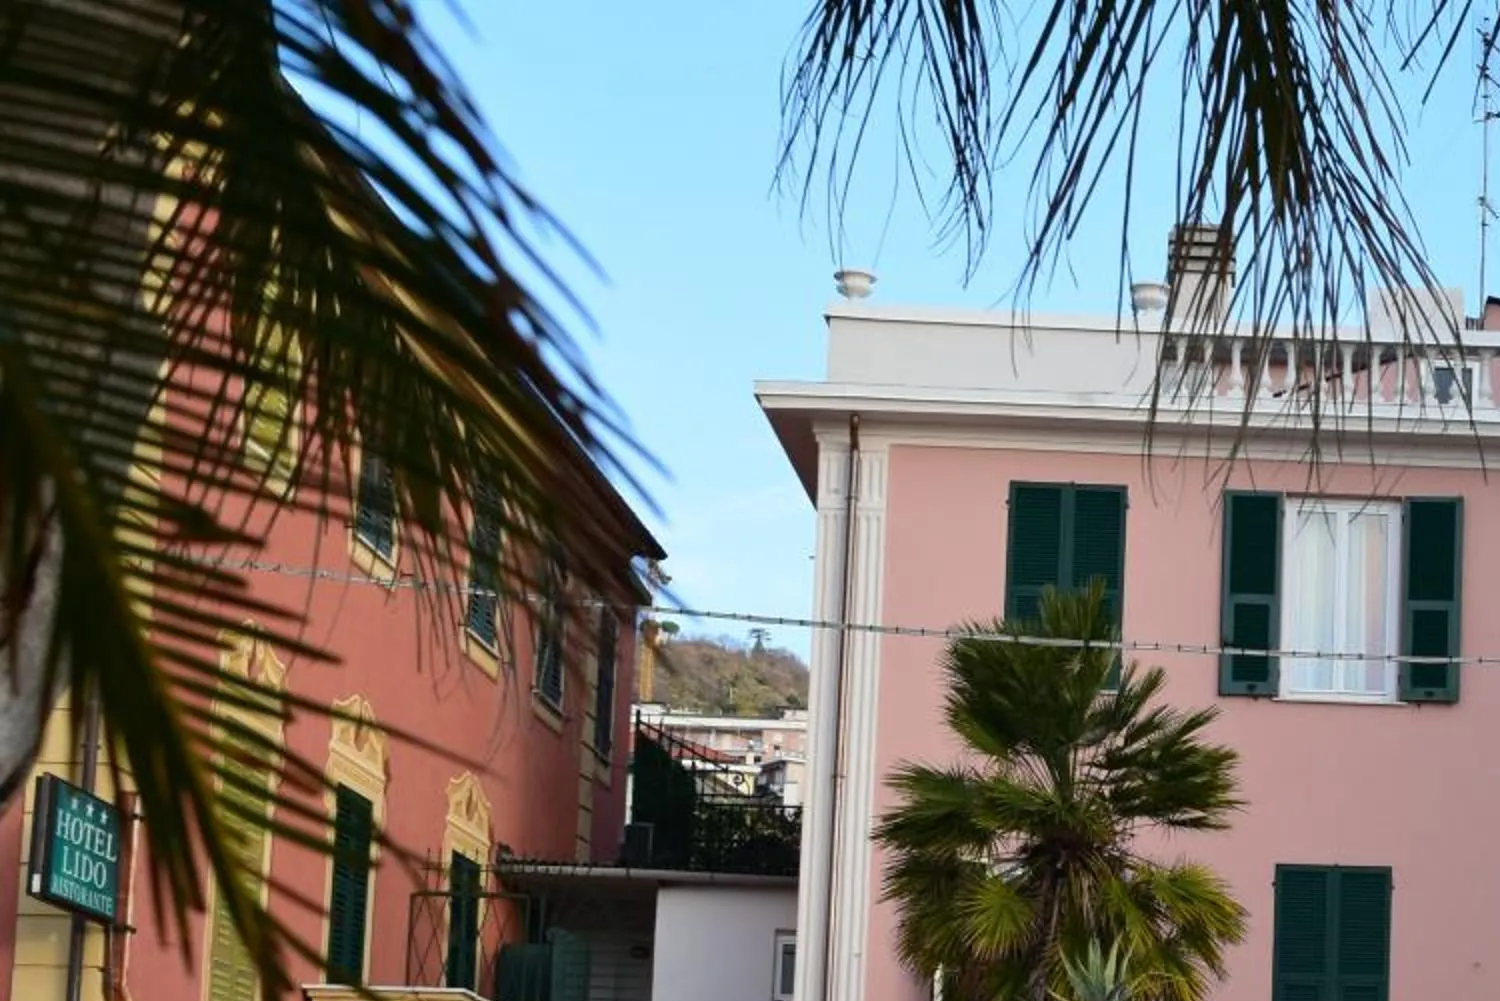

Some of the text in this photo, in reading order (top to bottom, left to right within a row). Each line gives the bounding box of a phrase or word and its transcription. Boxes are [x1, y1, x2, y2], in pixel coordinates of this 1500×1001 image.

[56, 809, 117, 862] HOTEL
[63, 846, 107, 889] LIDO
[51, 874, 113, 916] RISTORANTE
